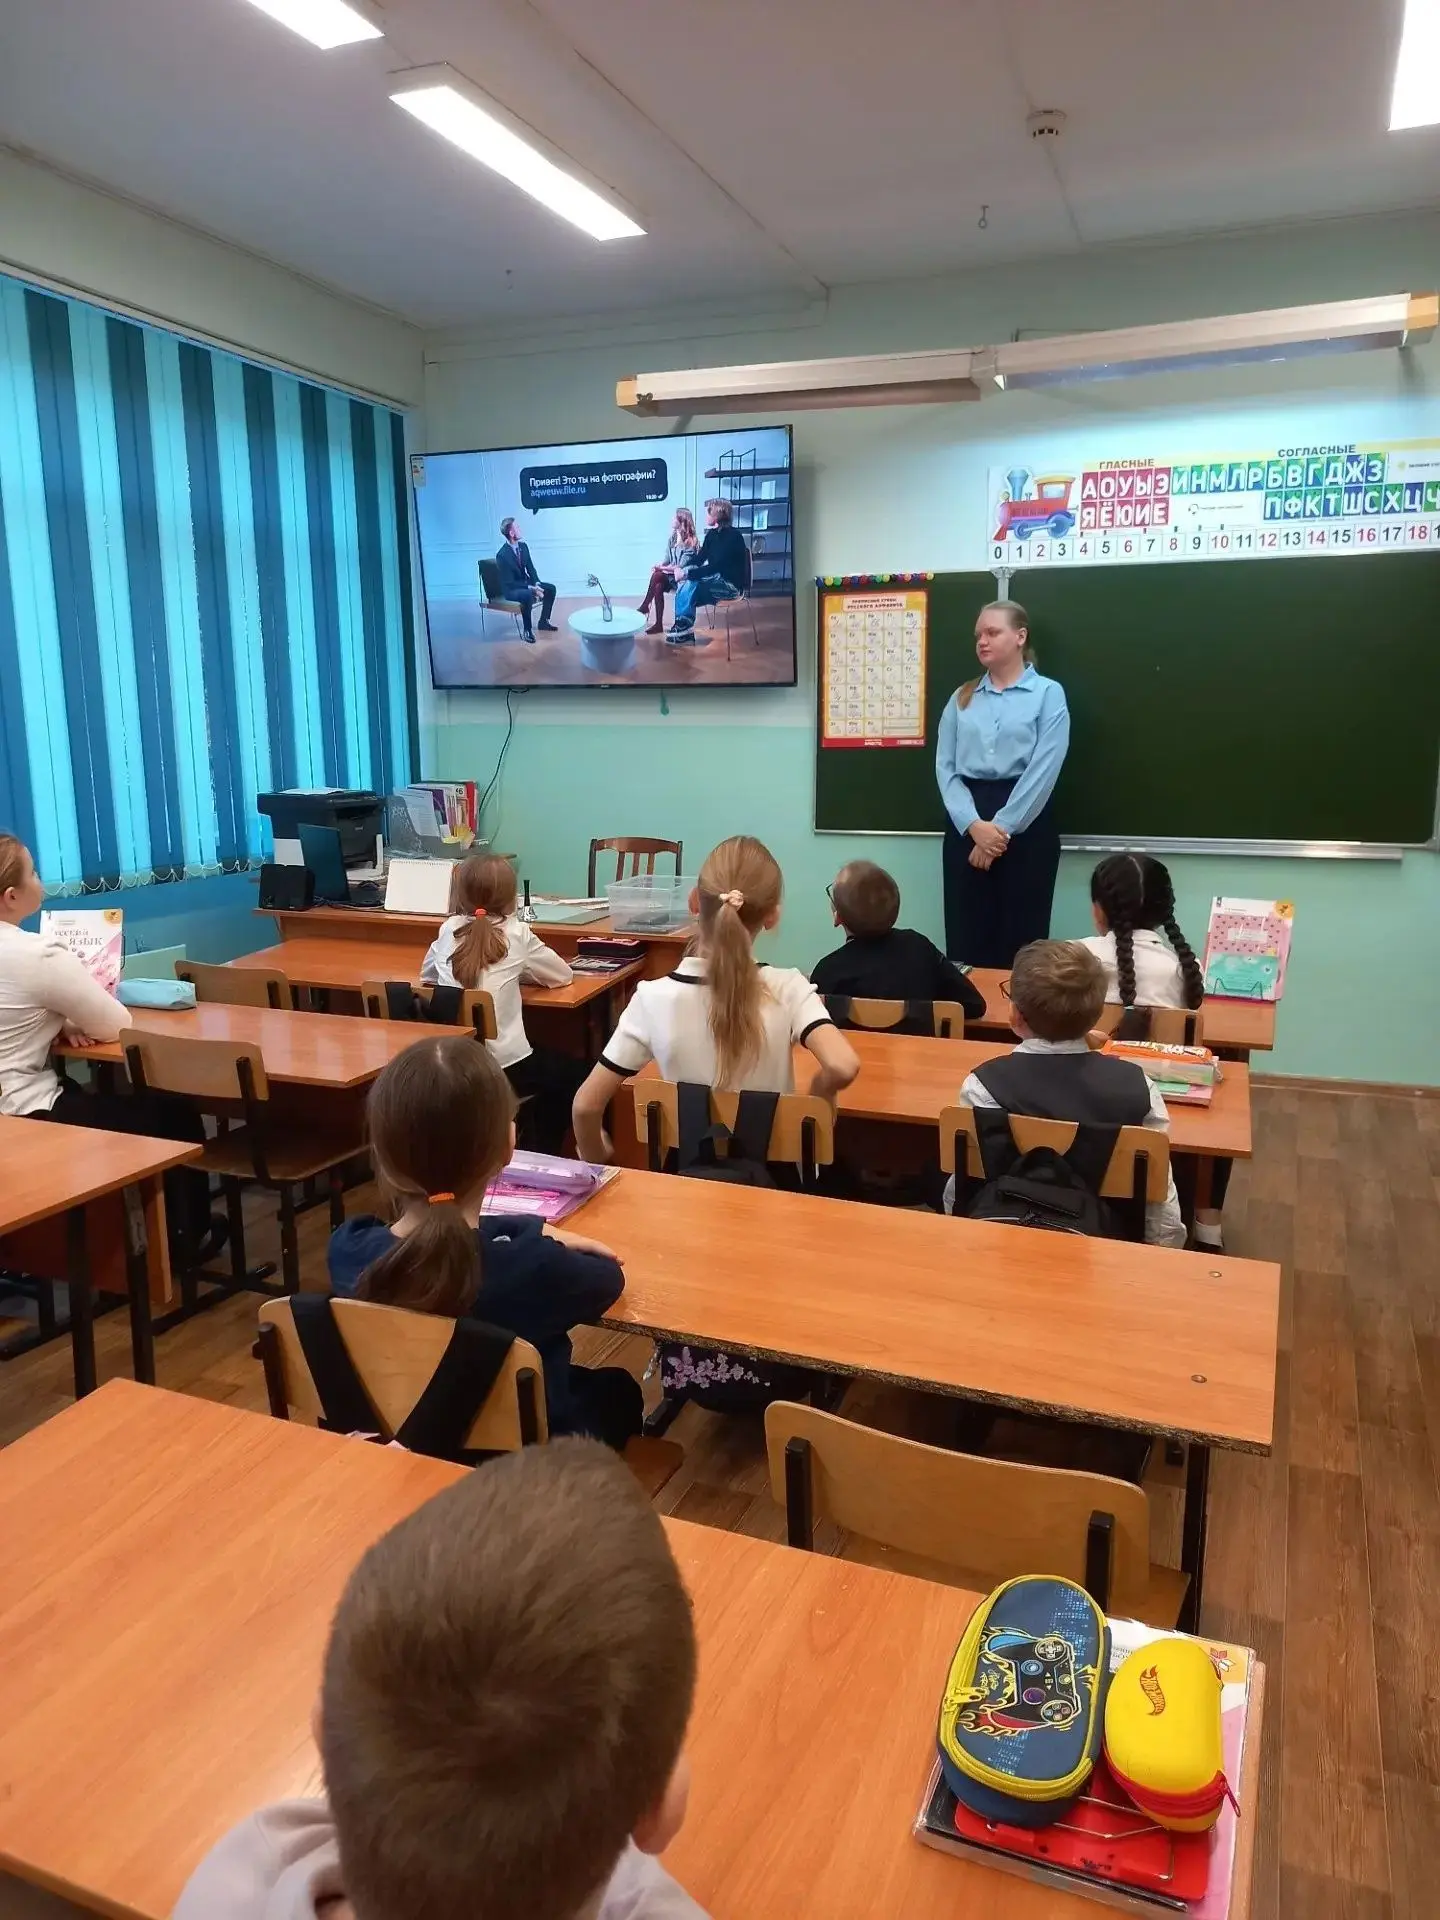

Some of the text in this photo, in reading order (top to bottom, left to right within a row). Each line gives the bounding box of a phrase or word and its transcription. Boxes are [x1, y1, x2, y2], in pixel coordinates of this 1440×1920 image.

[1278, 444, 1356, 457] СОГЛАСНЫЕ
[1099, 459, 1155, 469] ГЛАСНЫЕ
[530, 469, 656, 488] Привет! Это ты на фотографии?
[994, 525, 1440, 559] 0 1 2 3 4 5 6 7 8 9 10 11 12 13 14 15 16 17 18 1
